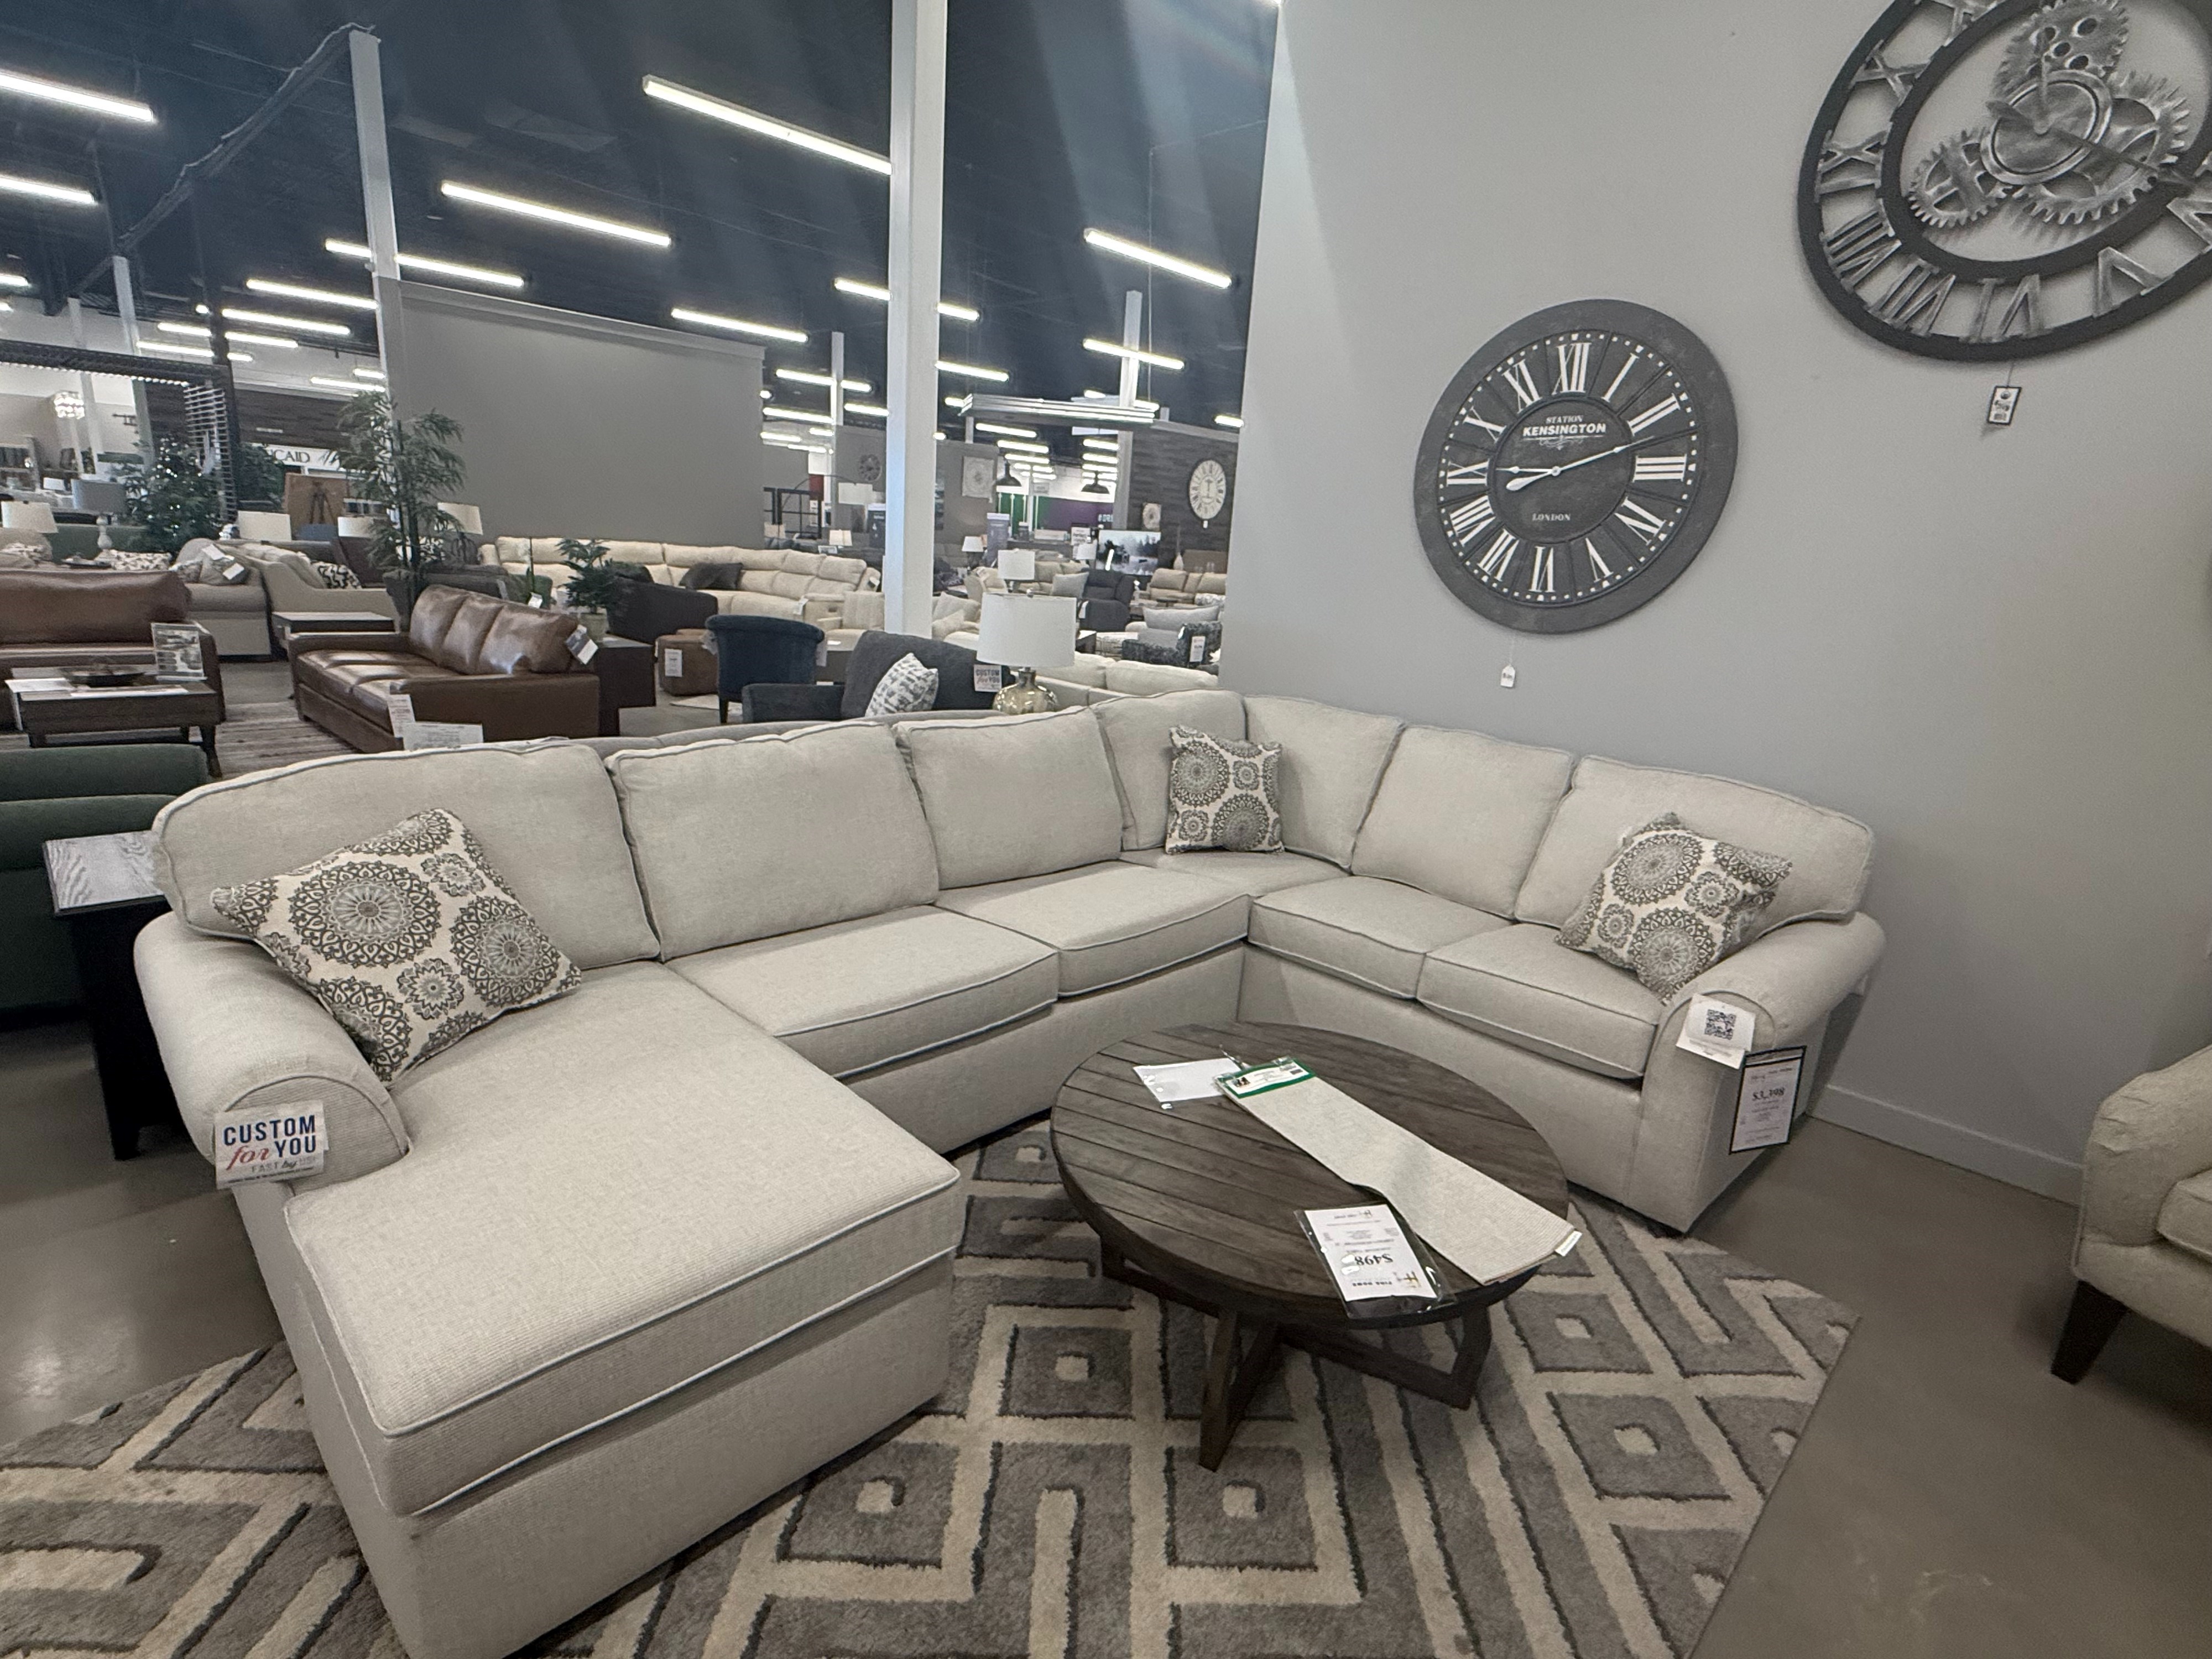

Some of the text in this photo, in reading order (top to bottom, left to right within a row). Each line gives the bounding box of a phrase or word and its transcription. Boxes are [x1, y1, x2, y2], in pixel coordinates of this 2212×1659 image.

[1552, 341, 1592, 396] XII
[1501, 358, 1543, 414] XI
[1463, 405, 1507, 443] X
[1522, 422, 1606, 437] KENSINGTON
[1546, 415, 1584, 424] STATION
[1626, 393, 1681, 437] II
[270, 448, 310, 463] CAID
[1632, 453, 1688, 483] III
[1531, 513, 1571, 521] LONDON
[223, 1115, 315, 1146] CUSTOM
[226, 1145, 270, 1171] for
[274, 1135, 316, 1158] YOU
[1354, 1253, 1394, 1266] $498
